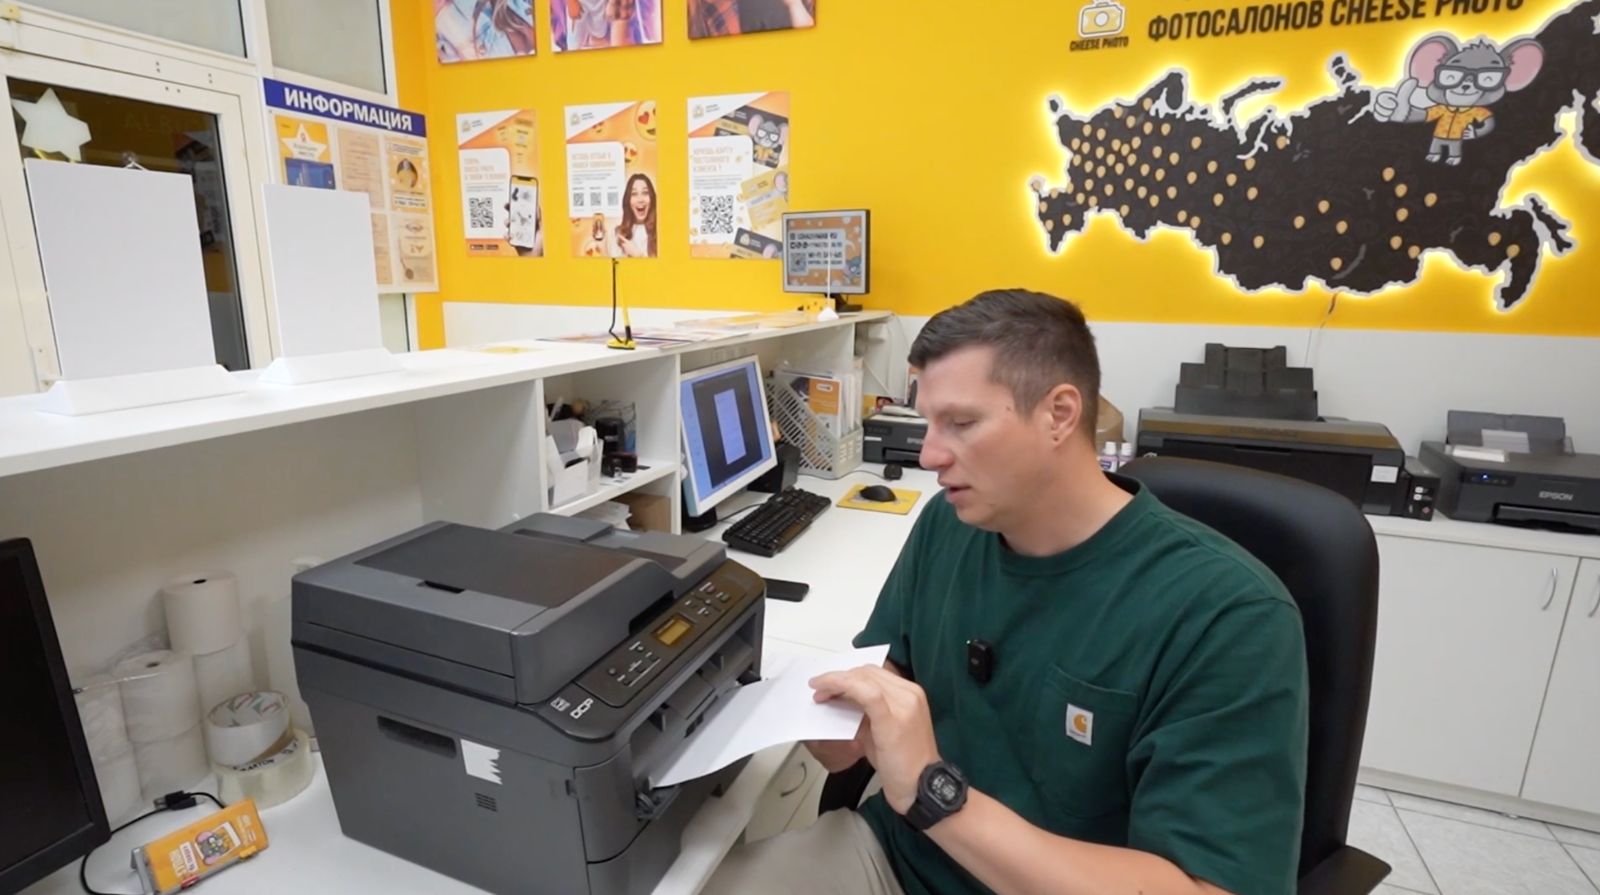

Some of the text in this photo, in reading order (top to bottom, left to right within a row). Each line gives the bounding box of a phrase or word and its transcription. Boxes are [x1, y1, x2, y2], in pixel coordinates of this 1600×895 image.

[1147, 0, 1325, 42] ФОТОСАЛОНОВ
[1330, 0, 1426, 26] CHEESE
[1069, 36, 1129, 52] CHEESE PHOTO
[284, 87, 413, 131] ИНФОРМАЦИЯ
[1539, 491, 1574, 501] EPSON
[570, 698, 594, 719] DCP
